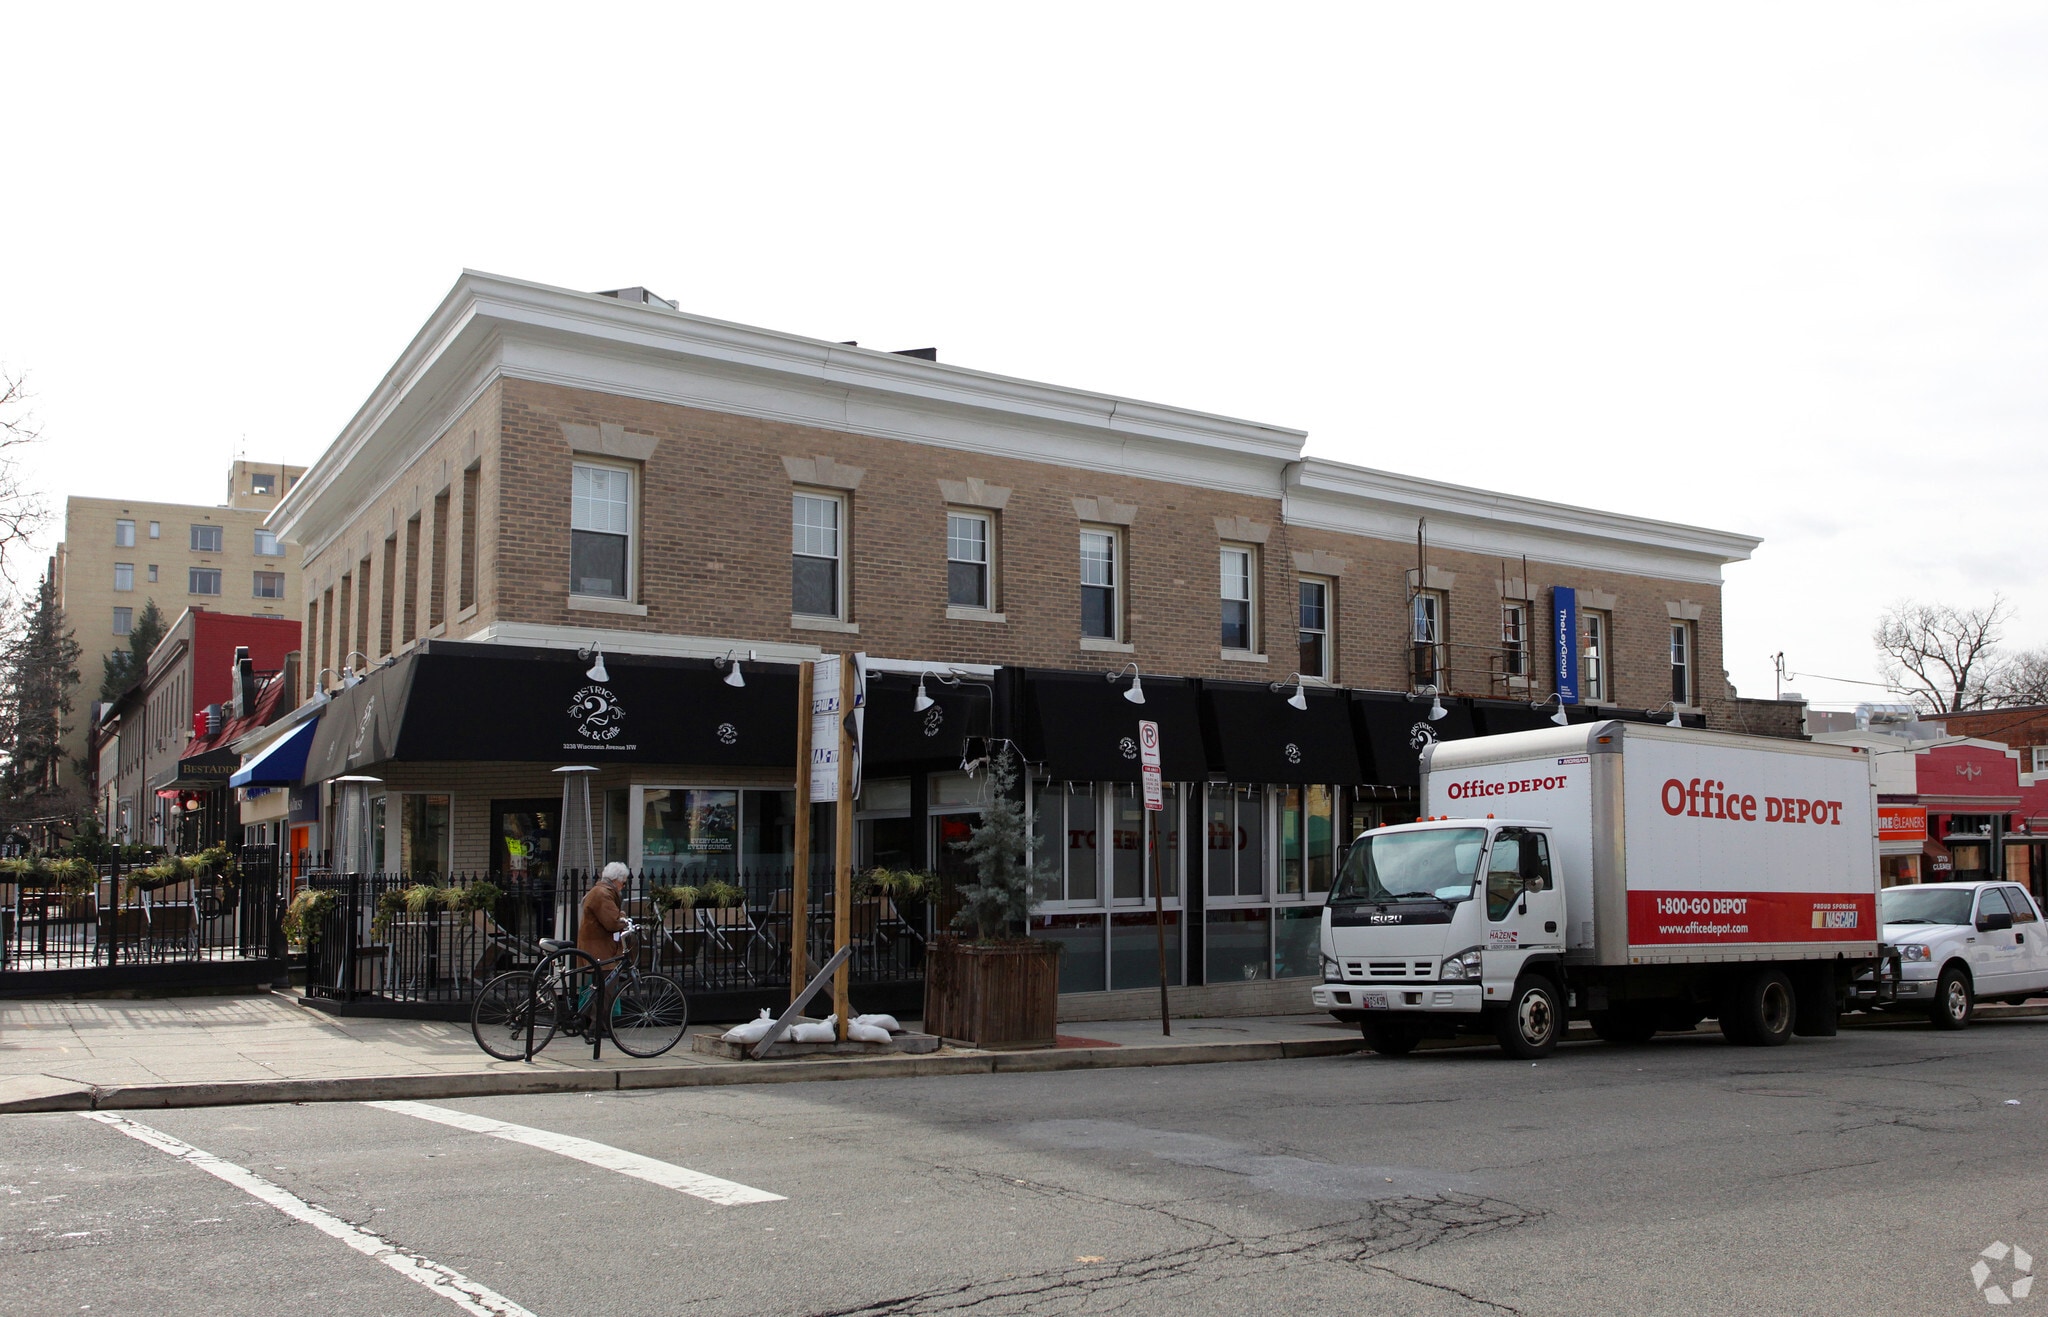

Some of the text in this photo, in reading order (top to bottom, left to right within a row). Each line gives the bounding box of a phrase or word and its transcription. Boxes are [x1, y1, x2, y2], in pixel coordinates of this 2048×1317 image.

[1560, 609, 1568, 679] TheLeyGroup
[573, 686, 618, 703] DISTRICT
[584, 696, 609, 725] 2
[578, 724, 591, 737] Bar
[592, 731, 601, 740] &
[1411, 722, 1438, 737] DISTRICT
[1448, 776, 1567, 799] Office DEPOT
[1662, 778, 1842, 825] Office DEPOT
[1657, 898, 1747, 915] 1-800-GO DEPOT
[1370, 915, 1402, 923] ISUZU
[1826, 912, 1855, 928] NASCAR
[1659, 921, 1749, 936] www.officedepot.com
